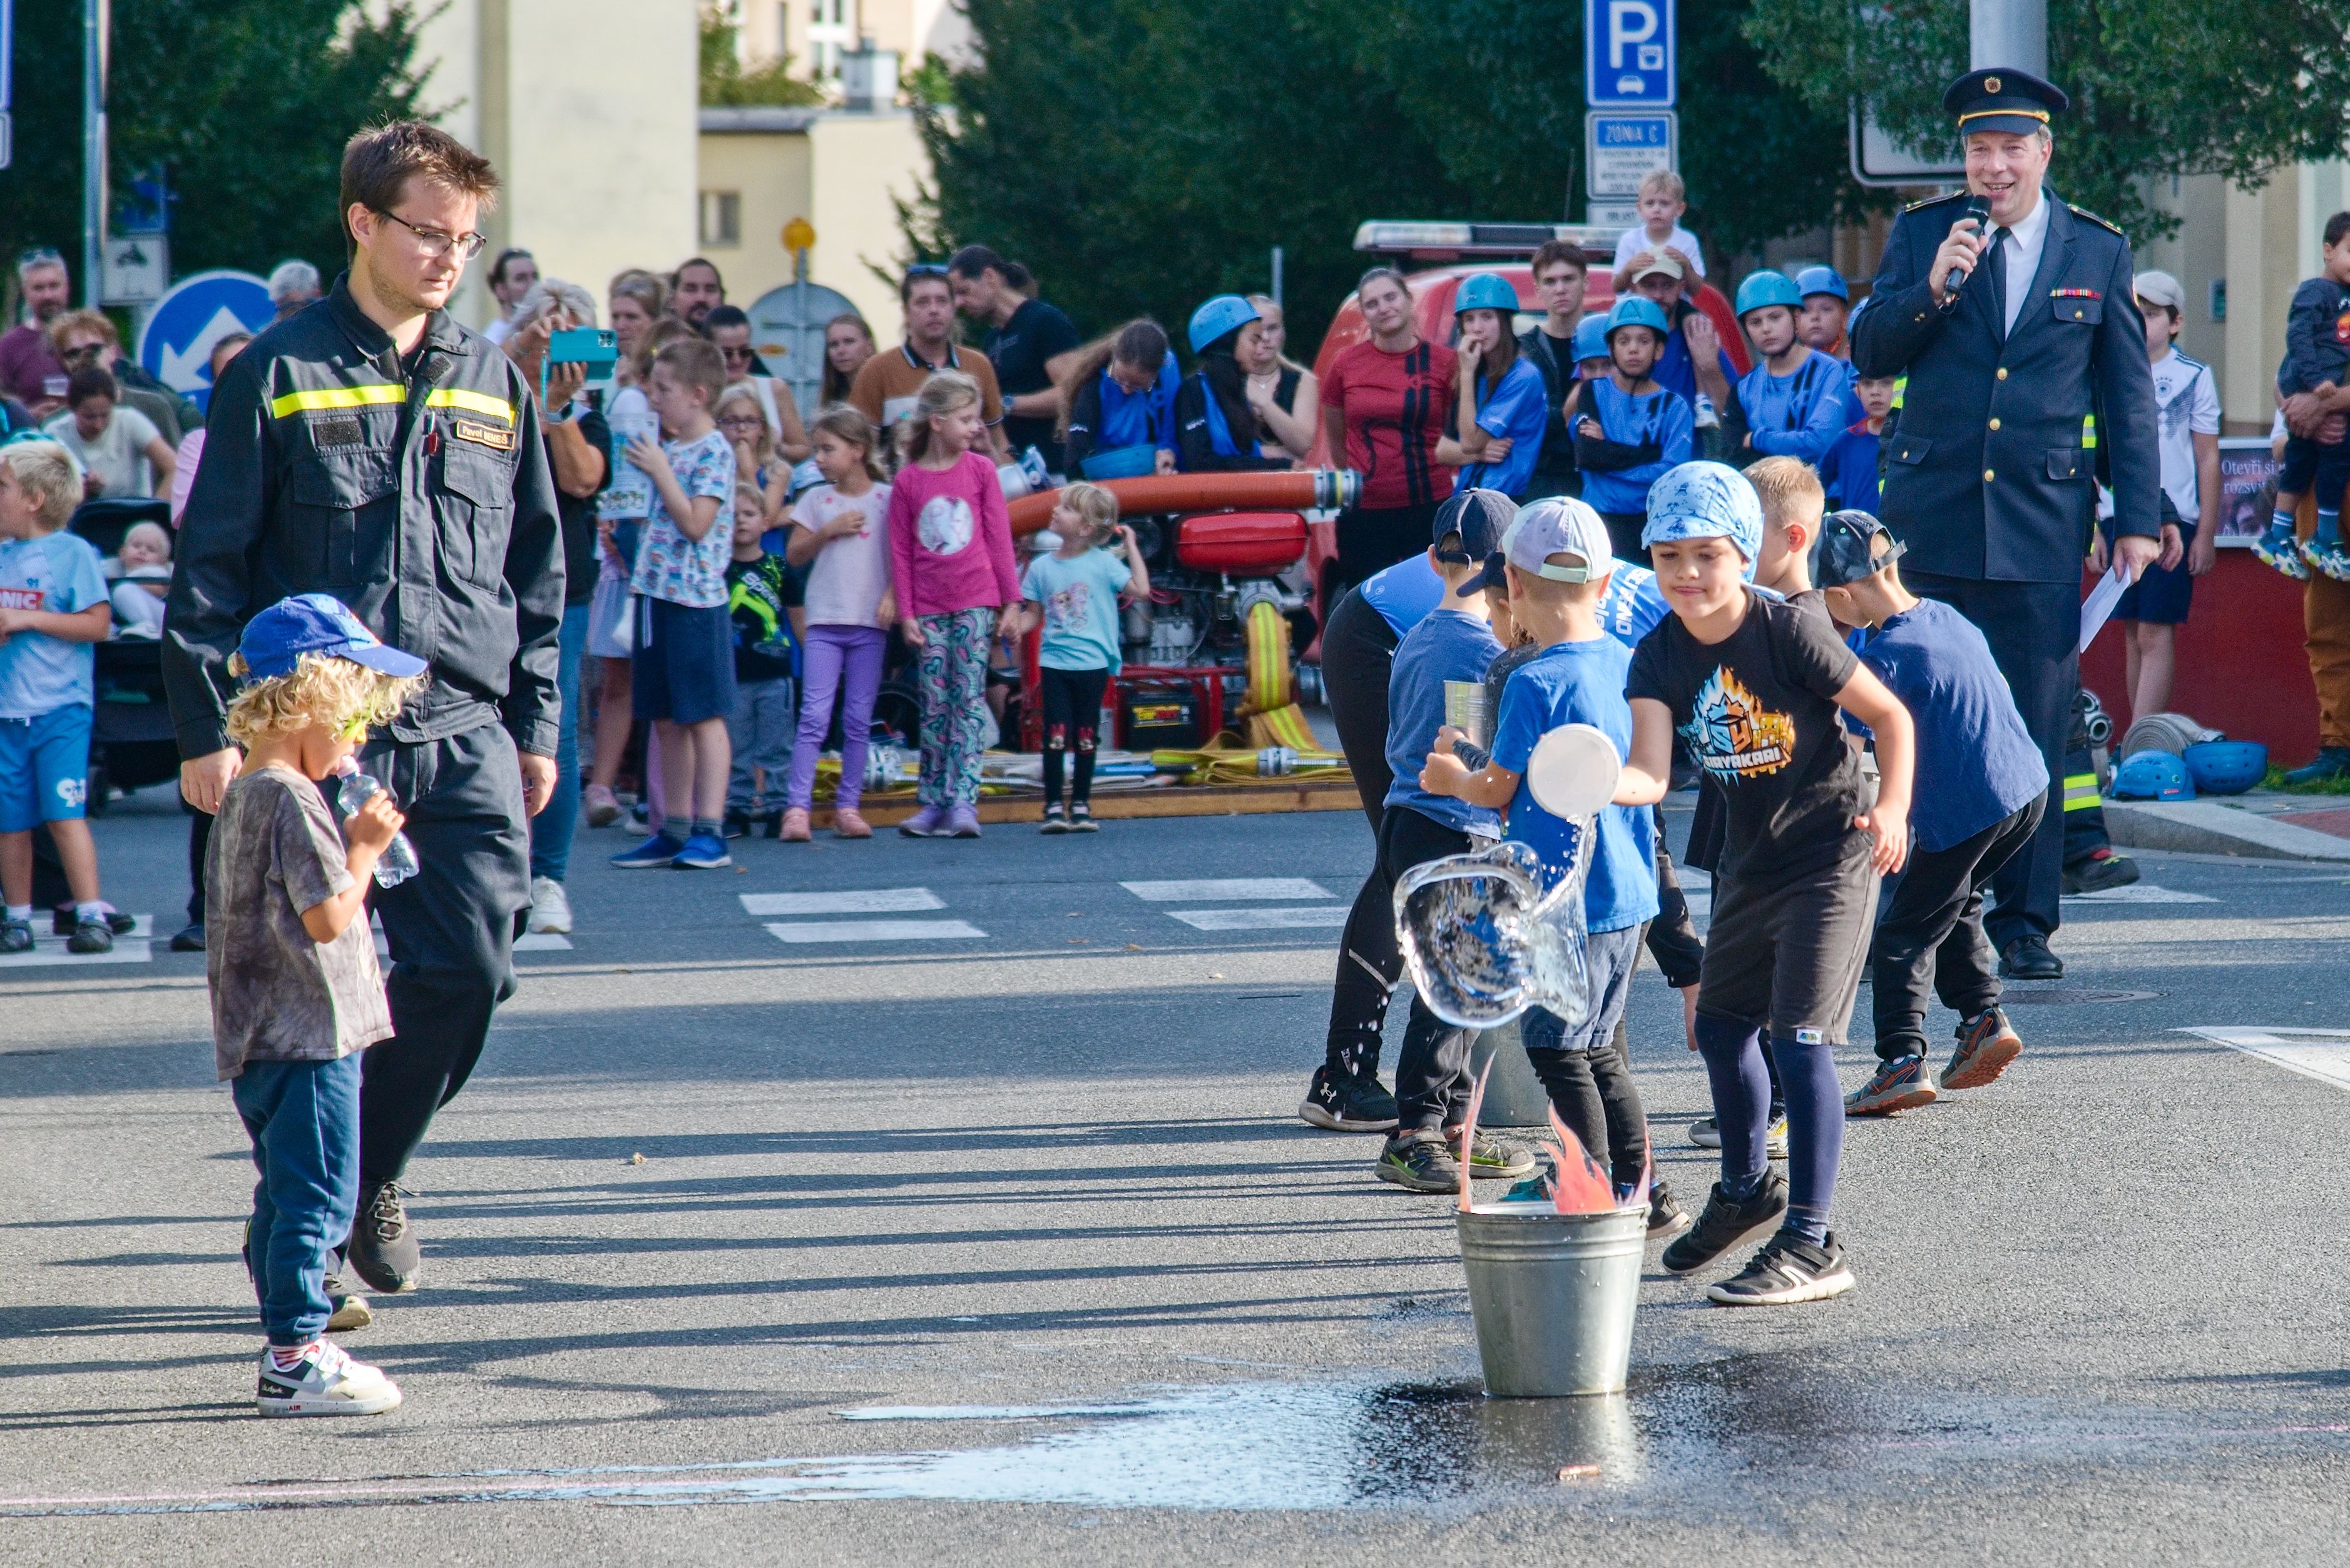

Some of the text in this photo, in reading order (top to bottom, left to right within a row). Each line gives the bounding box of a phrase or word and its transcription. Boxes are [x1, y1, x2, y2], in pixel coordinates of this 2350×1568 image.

[1609, 0, 1658, 69] P
[462, 425, 508, 444] Pavel BENEŠ
[2222, 459, 2261, 476] Otevři
[2264, 460, 2276, 475] si
[0, 591, 37, 611] NIC
